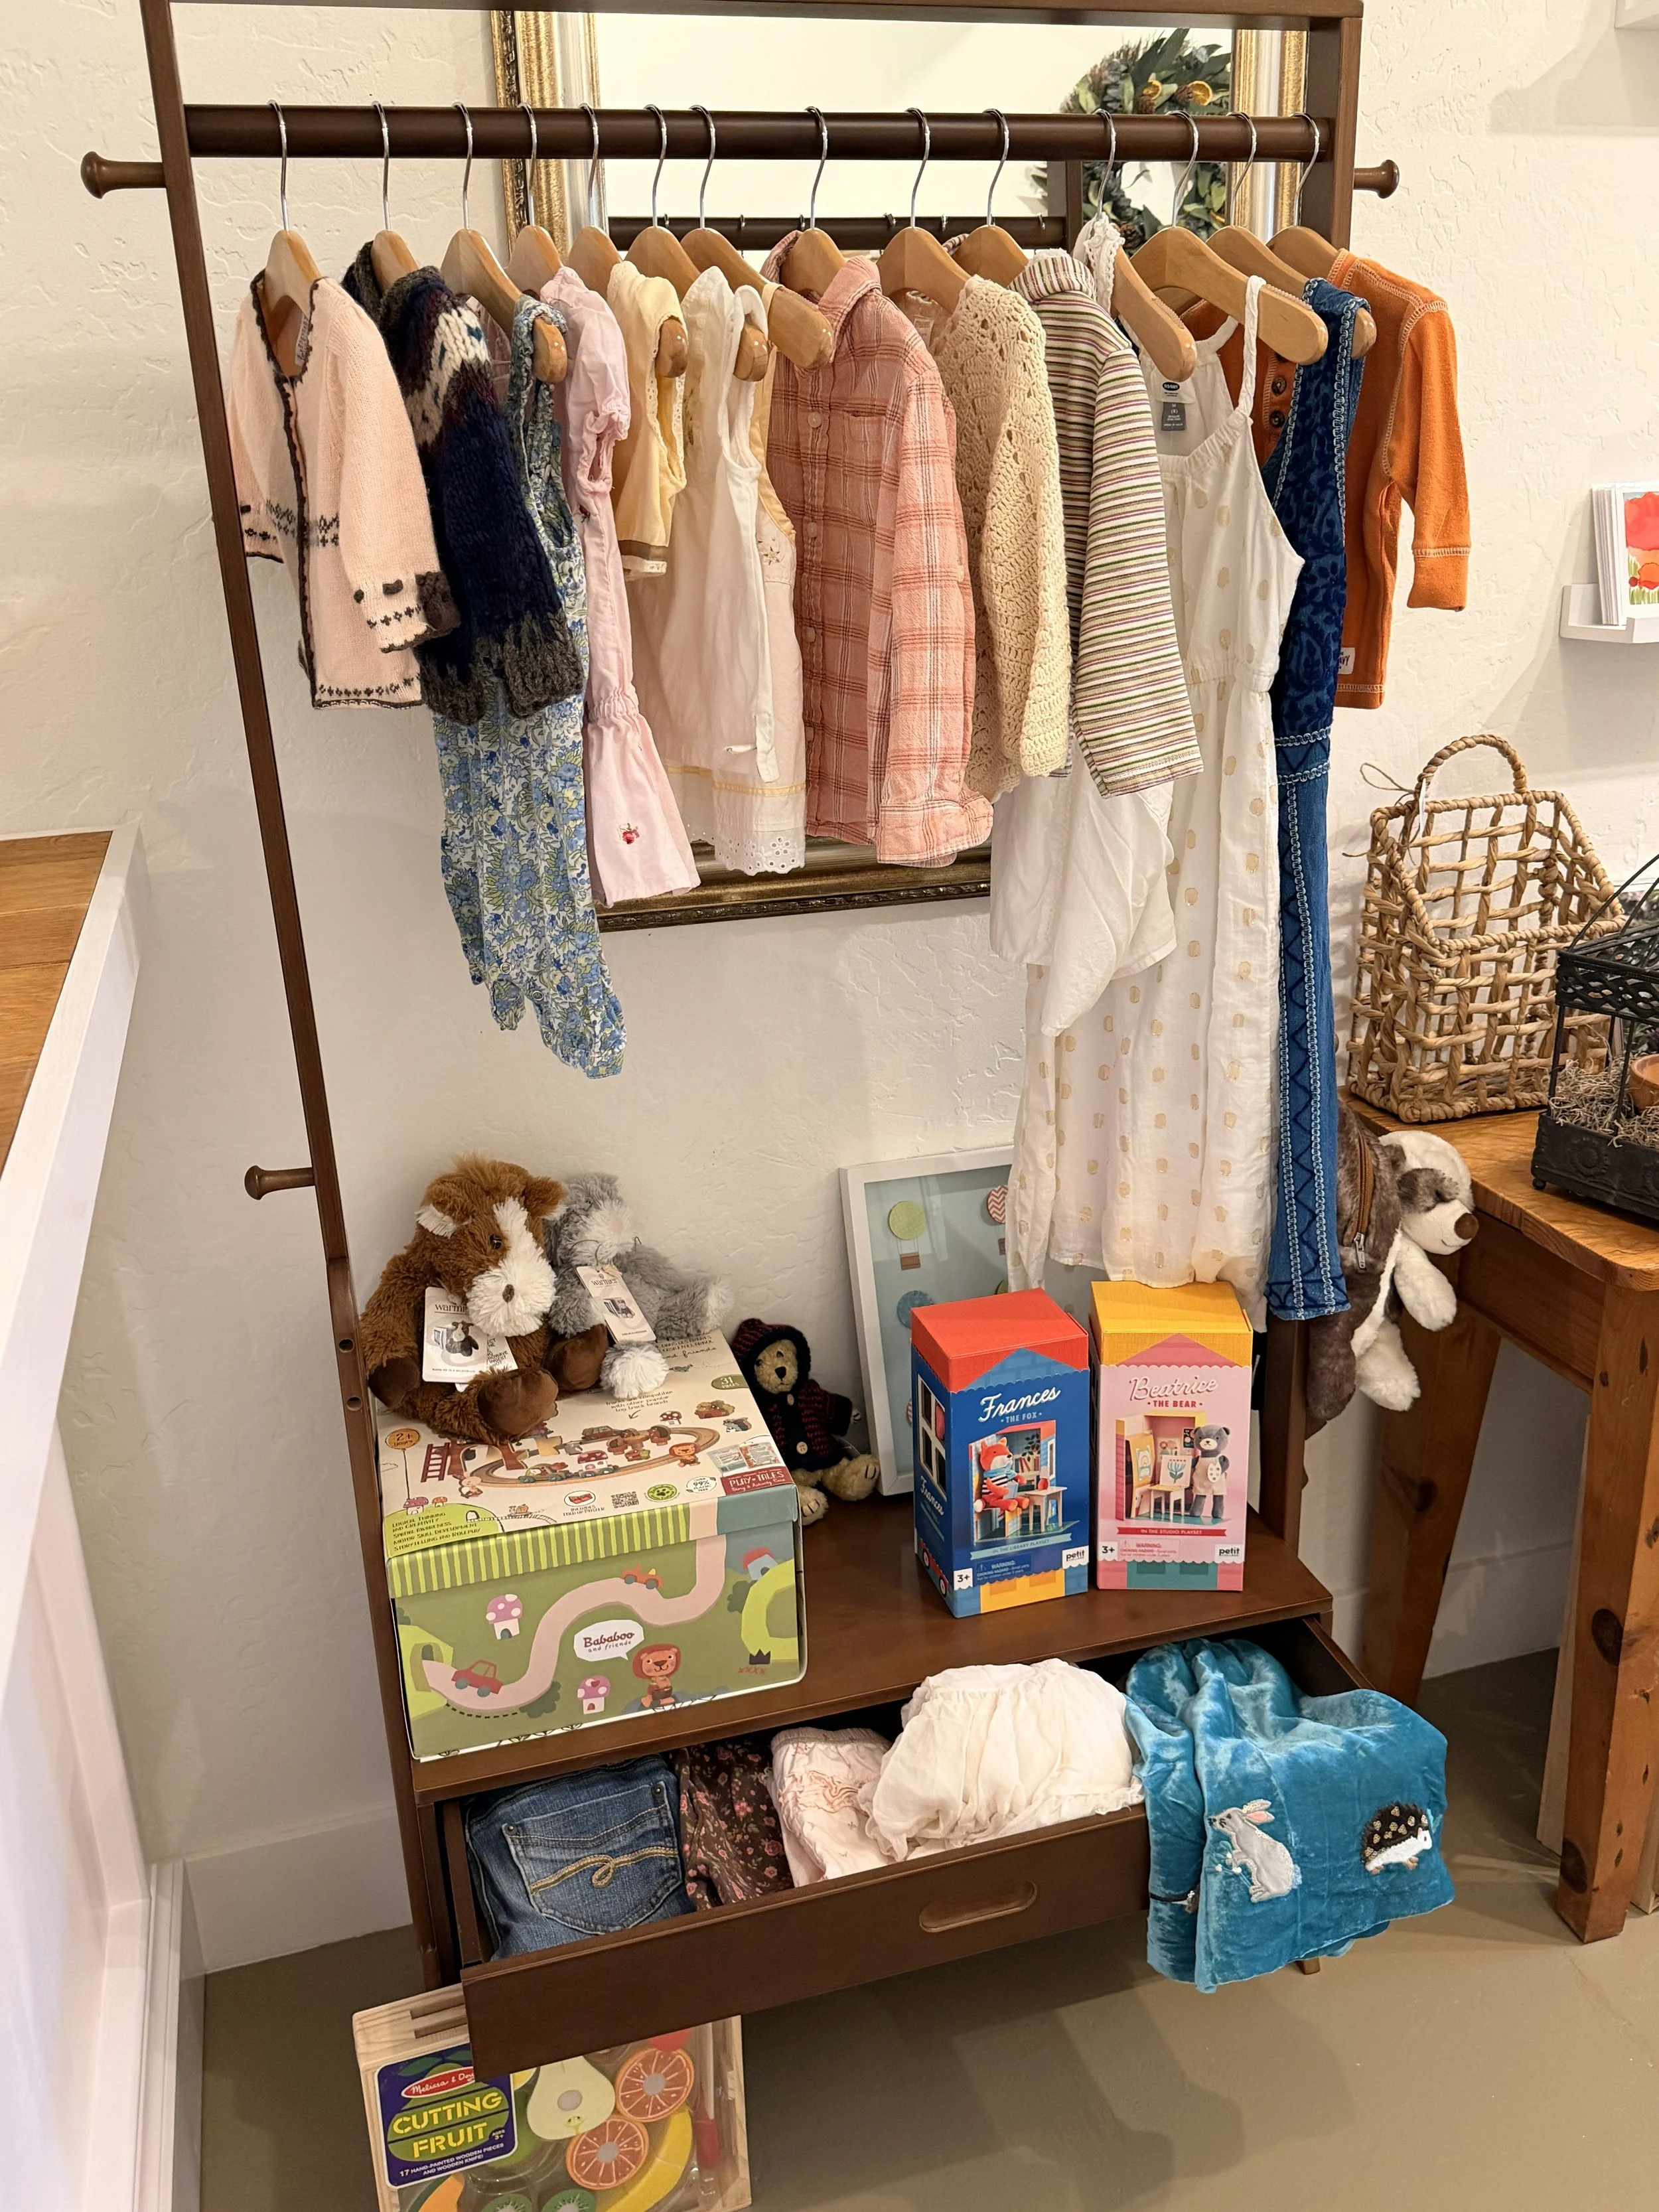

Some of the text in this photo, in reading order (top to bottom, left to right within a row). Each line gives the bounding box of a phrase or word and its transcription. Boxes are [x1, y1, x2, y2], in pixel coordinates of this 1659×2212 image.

[1129, 1375, 1219, 1401] Beatrice
[978, 1386, 1061, 1422] Frances
[1066, 1550, 1084, 1562] petit
[1219, 1548, 1240, 1556] petit
[957, 1574, 970, 1583] 3+
[583, 1632, 635, 1648] Bababoo
[605, 1640, 632, 1651] friends
[410, 2081, 449, 2095] Melissa
[393, 2092, 502, 2134] CUTTING
[413, 2122, 487, 2158] FRUIT
[411, 2157, 455, 2174] HAND-PAINTED
[455, 2149, 482, 2160] WOODEN
[483, 2143, 504, 2153] PIECES
[437, 2160, 464, 2172] WOODEN
[465, 2154, 484, 2164] KNIFE!
